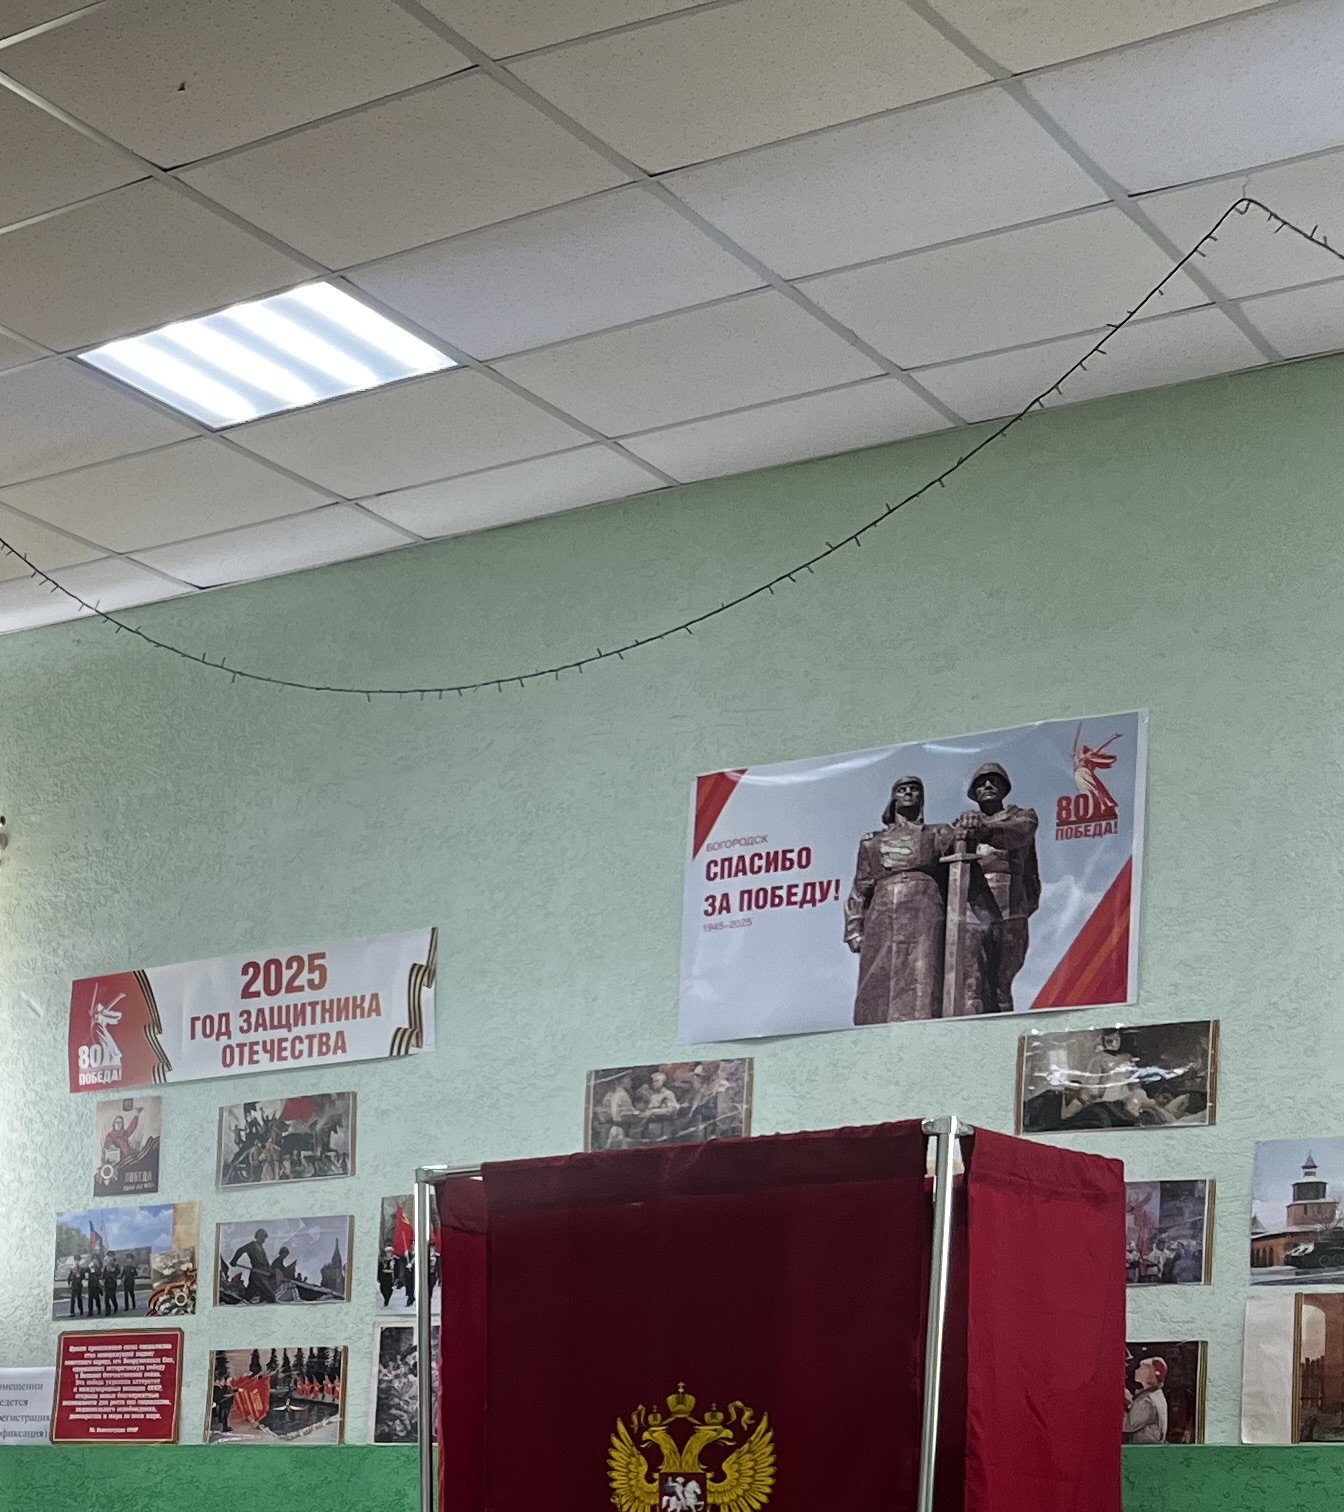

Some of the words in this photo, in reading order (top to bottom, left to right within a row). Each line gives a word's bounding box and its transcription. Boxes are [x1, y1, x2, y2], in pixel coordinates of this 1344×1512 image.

[1056, 793, 1090, 822] 80
[706, 835, 769, 852] БОГОРОДСК
[1055, 821, 1119, 841] ПОБЕДА!
[705, 846, 812, 882] СПАСИБО
[703, 892, 731, 917] ЗА
[738, 879, 841, 912] ПОБЕДУ!
[240, 952, 328, 999] 2025
[190, 1012, 232, 1041] ГОД
[238, 992, 382, 1034] ЗАЩИТНИКА
[78, 1044, 102, 1069] 80
[221, 1030, 347, 1068] ОТЕЧЕСТВА
[78, 1069, 123, 1086] ПОБЕДА!
